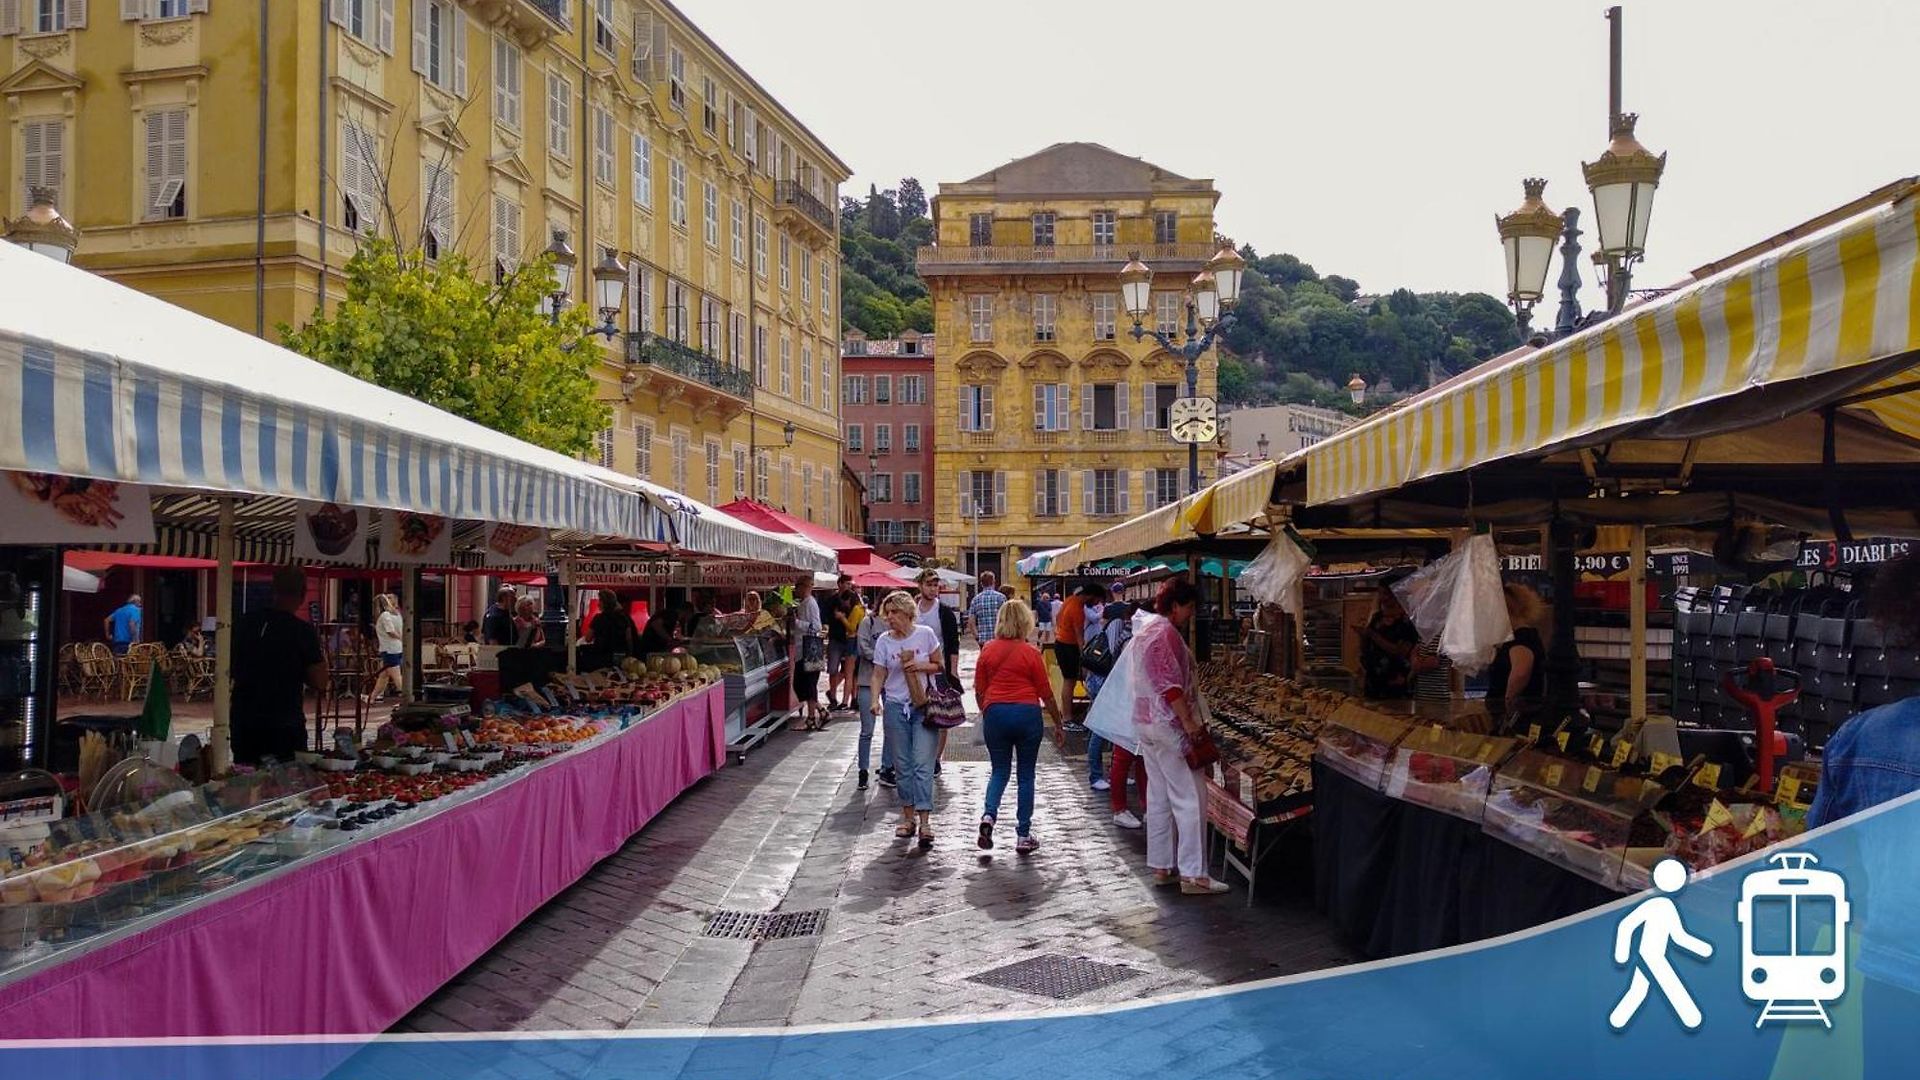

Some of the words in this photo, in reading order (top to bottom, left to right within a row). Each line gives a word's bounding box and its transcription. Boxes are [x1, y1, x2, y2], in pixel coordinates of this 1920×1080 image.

[1825, 542, 1838, 568] 3
[609, 562, 627, 574] DU
[1611, 556, 1622, 569] €
[1083, 567, 1131, 576] CONTAINER
[1672, 564, 1689, 575] 1991
